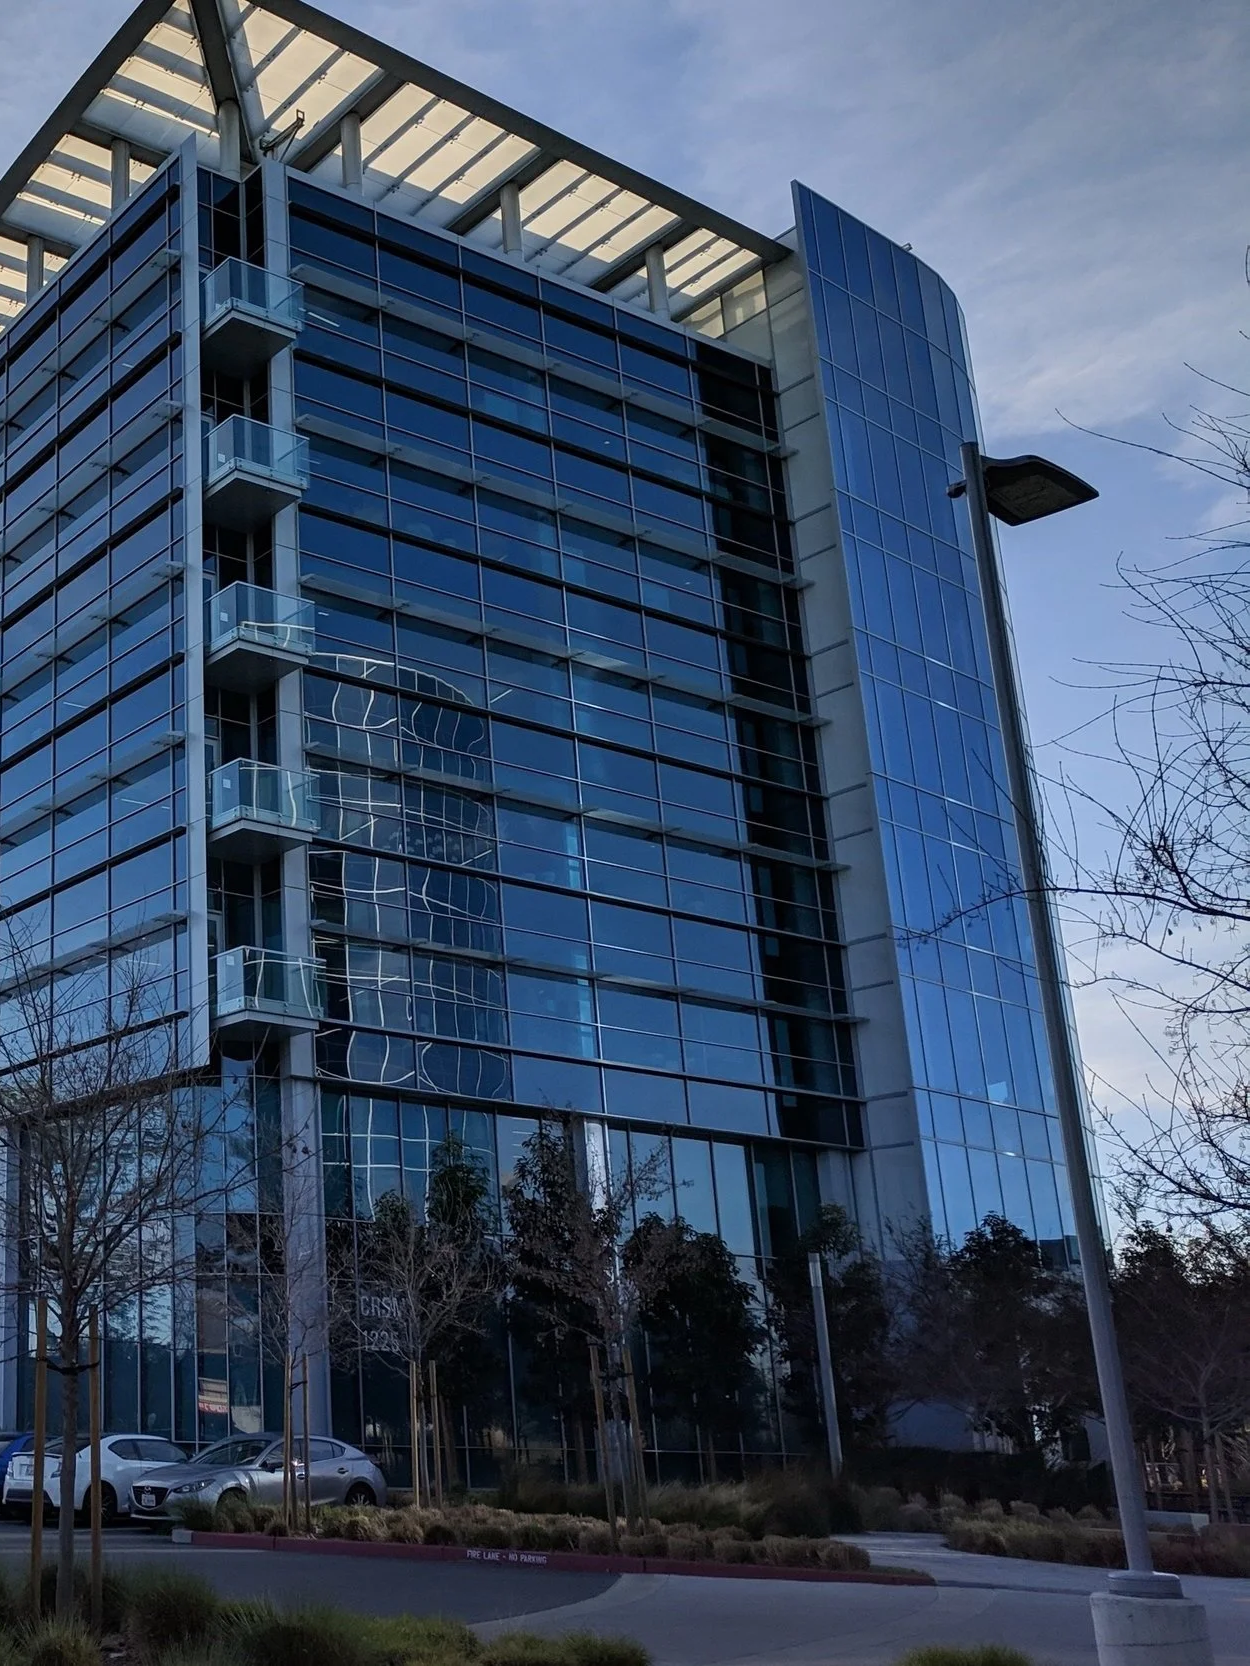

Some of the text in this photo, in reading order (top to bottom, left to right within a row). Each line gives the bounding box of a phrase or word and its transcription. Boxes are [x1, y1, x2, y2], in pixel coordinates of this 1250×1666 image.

[466, 1550, 481, 1559] FIRE
[483, 1551, 501, 1561] LANE
[508, 1552, 518, 1561] NO
[520, 1553, 548, 1564] PARKING
